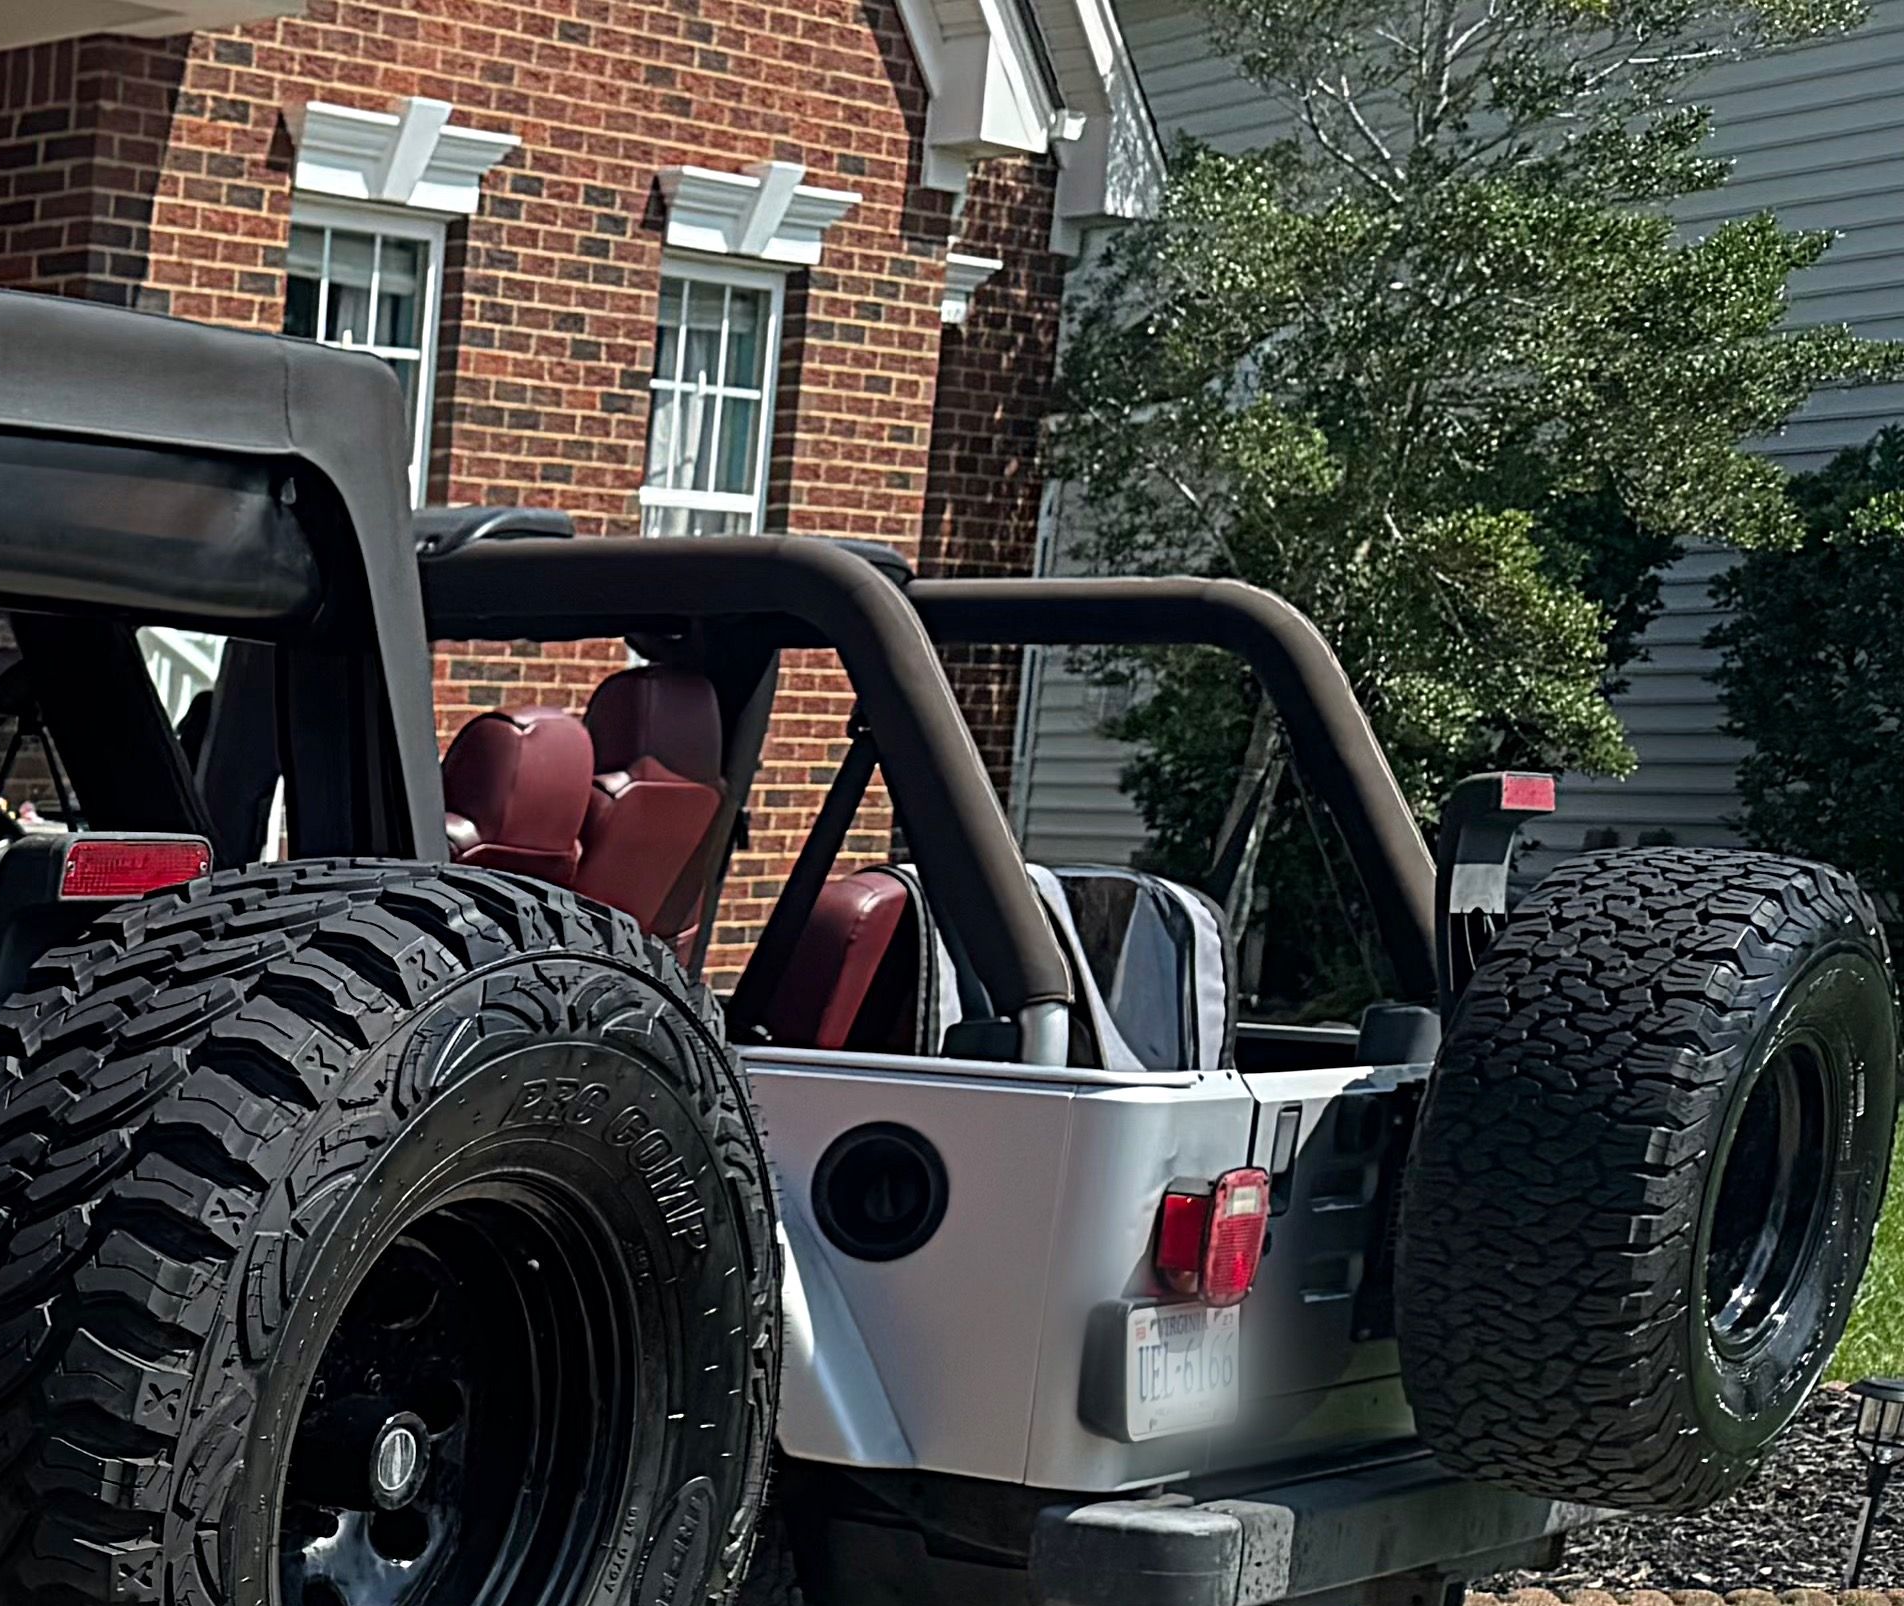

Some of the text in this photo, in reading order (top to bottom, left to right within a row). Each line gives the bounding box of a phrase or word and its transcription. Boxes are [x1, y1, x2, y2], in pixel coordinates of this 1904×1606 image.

[498, 1078, 710, 1250] PRO COMP
[1158, 1312, 1209, 1338] VIRGINIA
